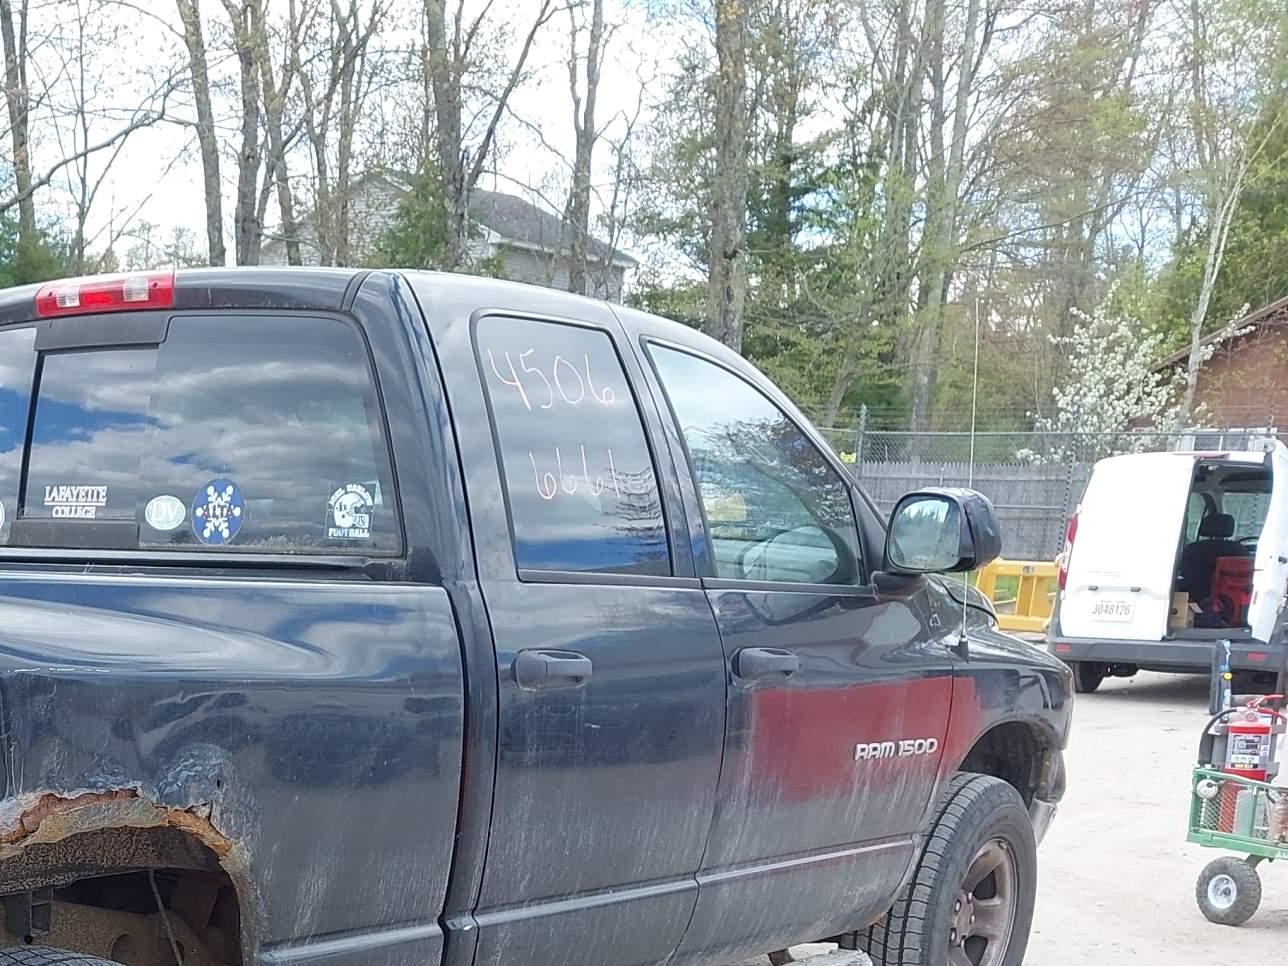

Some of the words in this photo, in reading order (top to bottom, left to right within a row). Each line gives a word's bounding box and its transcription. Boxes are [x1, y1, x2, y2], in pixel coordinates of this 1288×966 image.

[487, 347, 615, 411] 4506
[528, 444, 621, 500] 6661
[44, 485, 108, 502] LAFAYETTE
[52, 505, 96, 519] COLLEGE
[152, 500, 180, 521] DV
[328, 527, 369, 538] FOOTBALL
[854, 741, 896, 761] RAM
[898, 737, 938, 757] 1500
